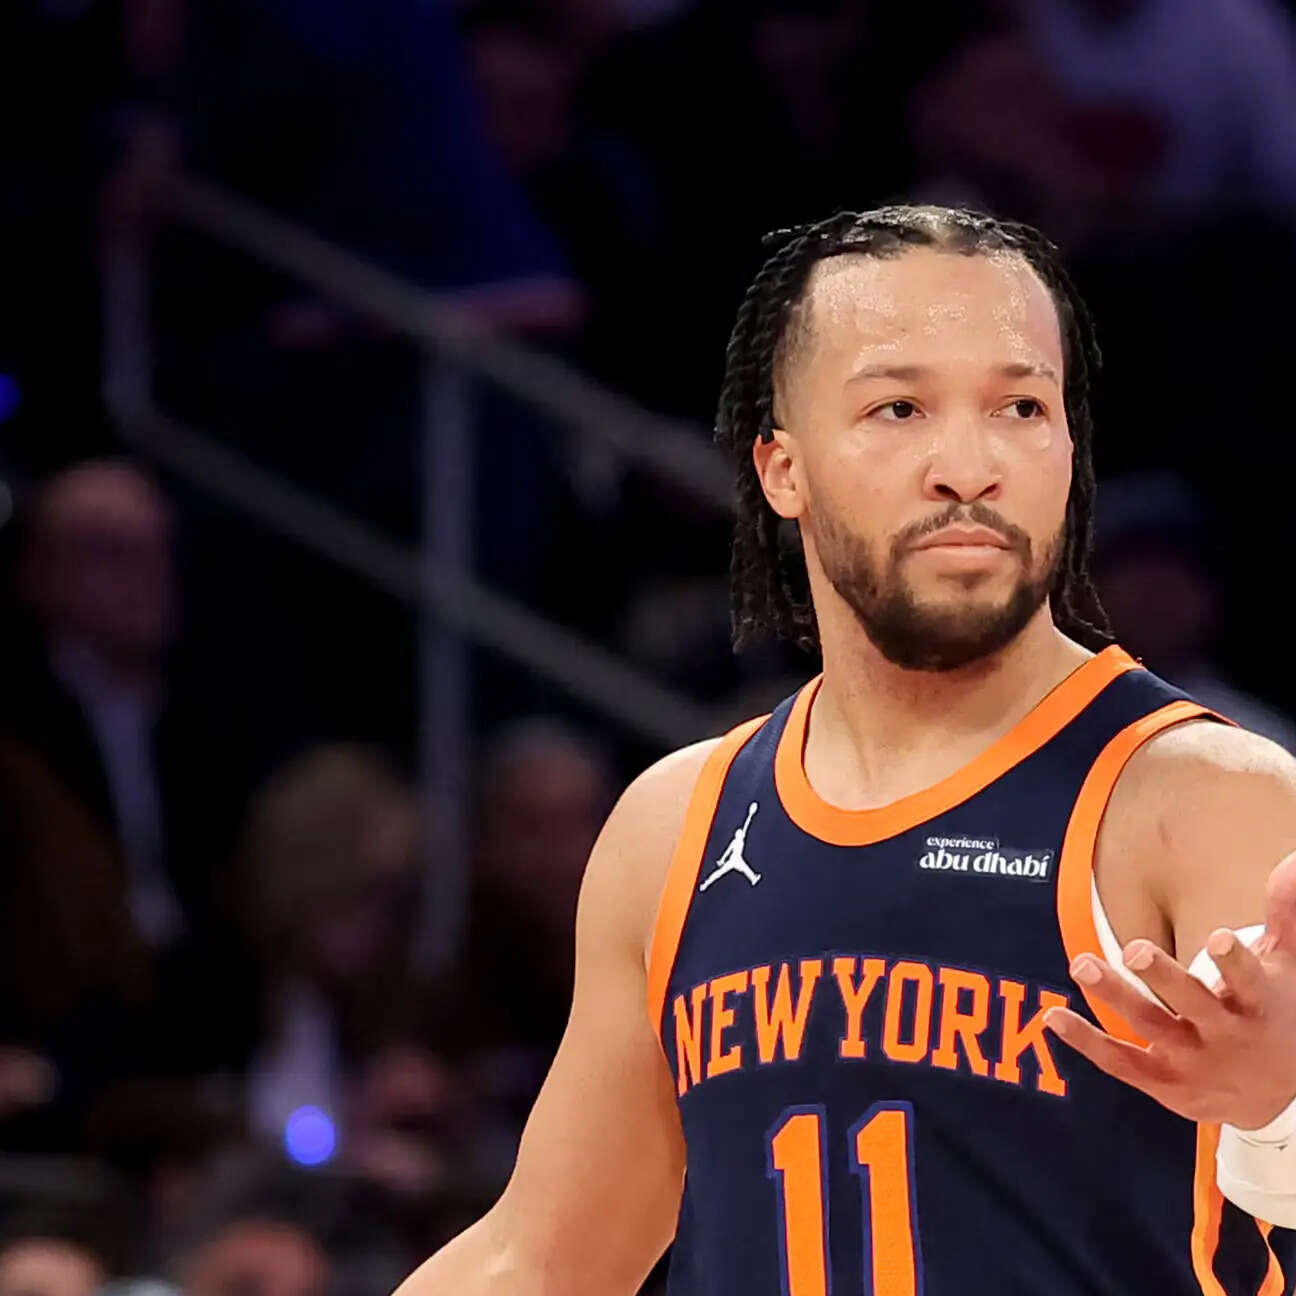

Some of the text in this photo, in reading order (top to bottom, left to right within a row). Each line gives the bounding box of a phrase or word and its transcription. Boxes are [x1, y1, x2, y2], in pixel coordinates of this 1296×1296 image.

[926, 836, 995, 849] experience
[919, 849, 970, 872] abu
[672, 954, 1071, 1099] NEW YORK
